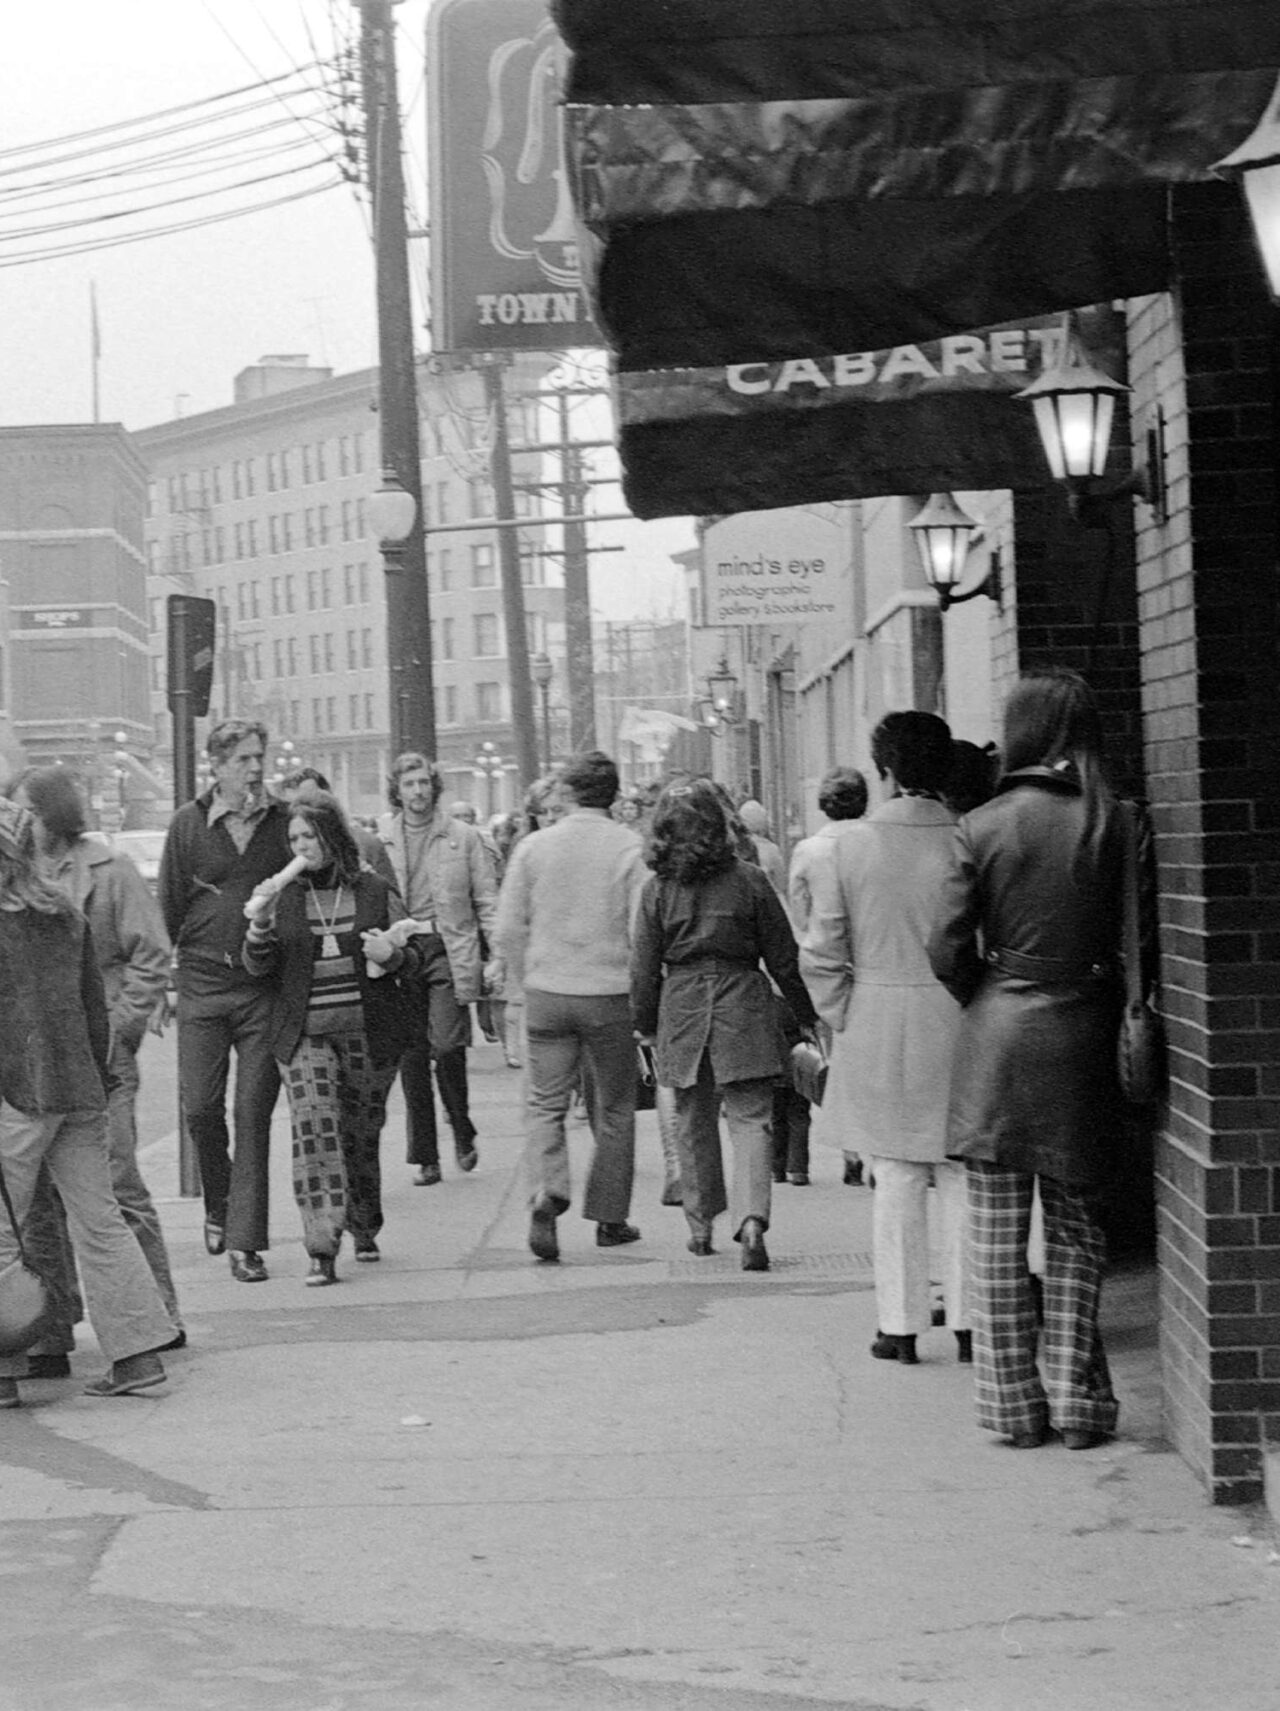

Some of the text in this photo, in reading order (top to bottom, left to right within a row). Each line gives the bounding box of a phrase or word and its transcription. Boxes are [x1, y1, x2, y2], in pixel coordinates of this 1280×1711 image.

[476, 292, 579, 325] TOWN
[726, 327, 1066, 395] CABARET
[717, 553, 826, 579] mind's eye
[718, 584, 811, 600] photographic
